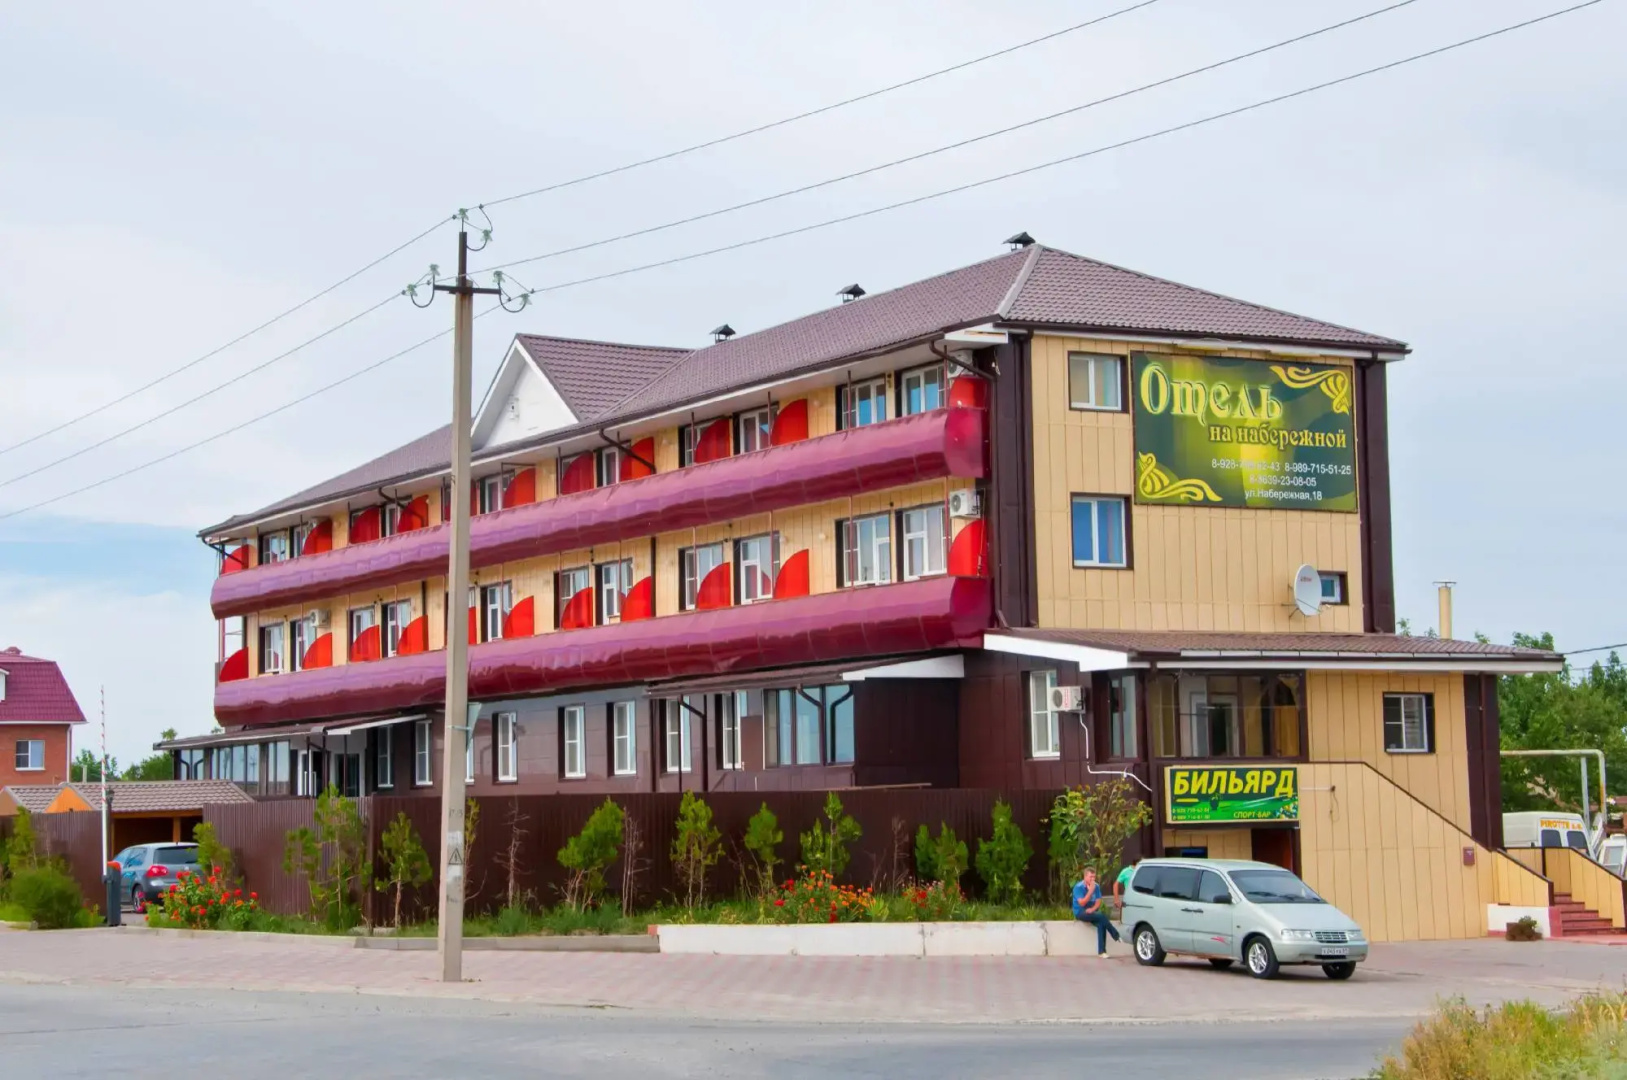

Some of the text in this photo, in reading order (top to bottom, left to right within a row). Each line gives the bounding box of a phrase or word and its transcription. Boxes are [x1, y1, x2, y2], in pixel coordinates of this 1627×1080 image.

[1140, 361, 1283, 426] Отель
[1209, 424, 1347, 449] на набережной
[1284, 462, 1352, 475] 8-989-715-51-25
[1173, 769, 1294, 798] БИЛЬЯРД
